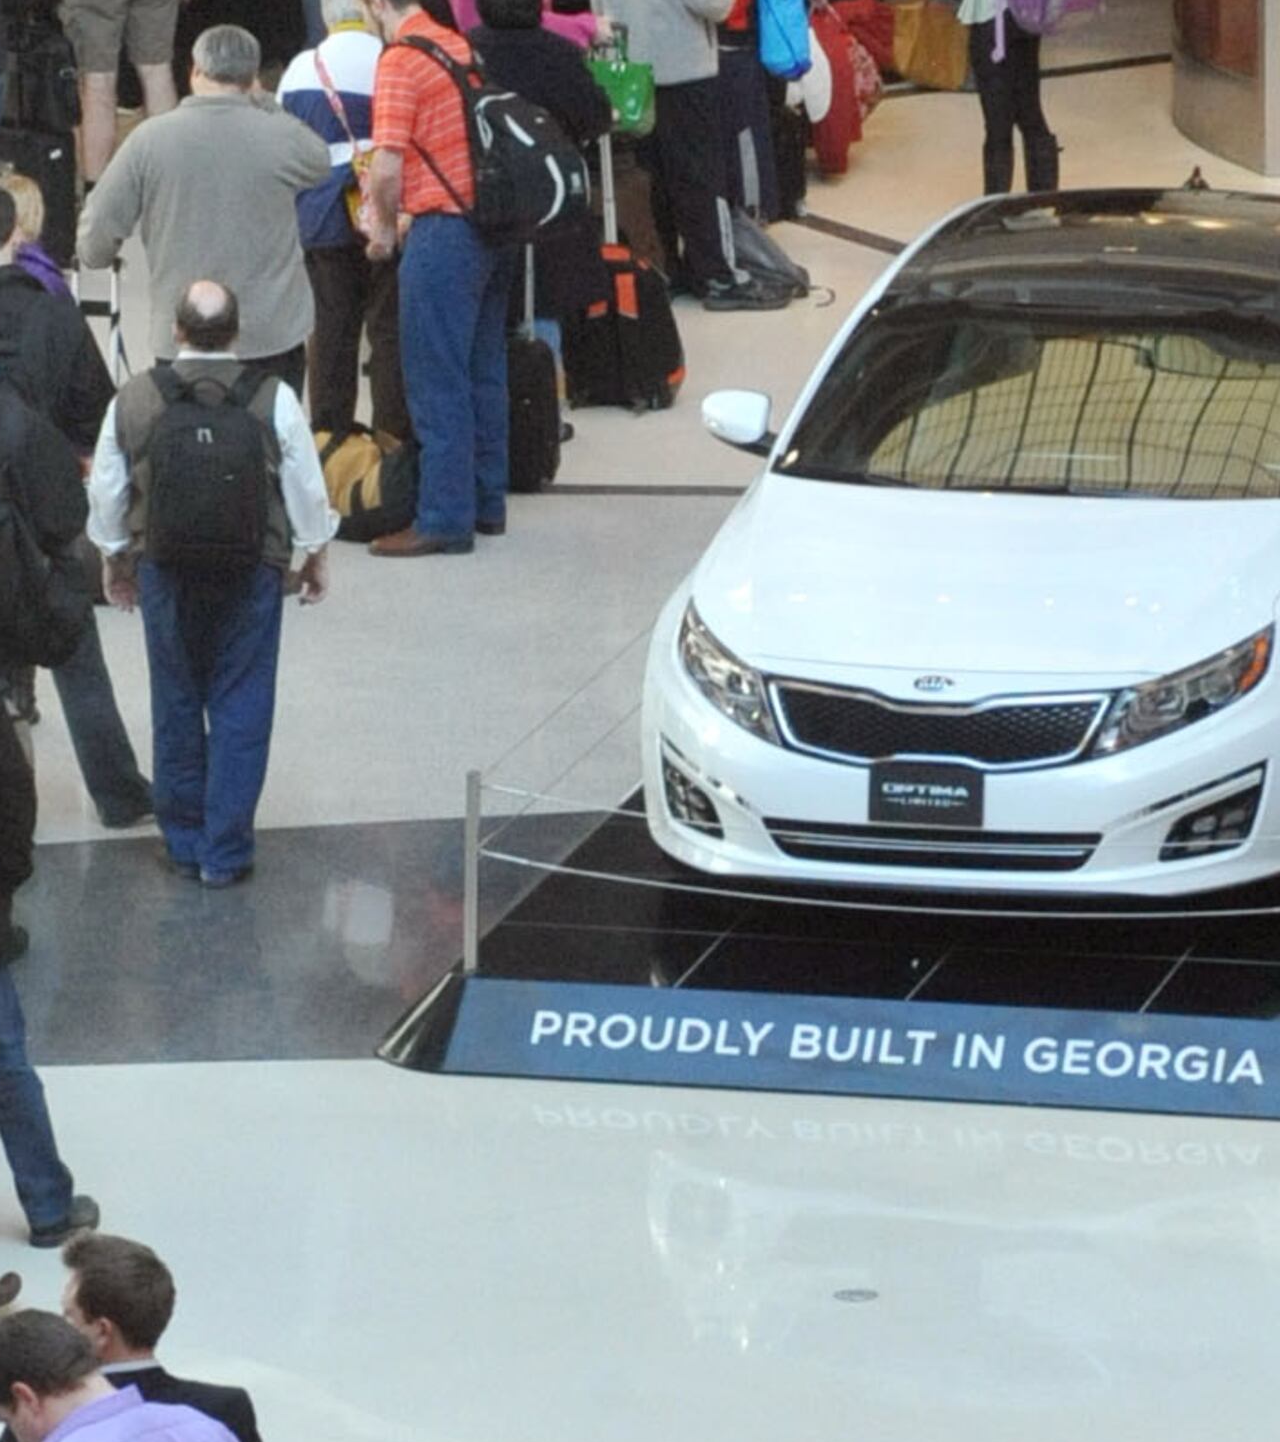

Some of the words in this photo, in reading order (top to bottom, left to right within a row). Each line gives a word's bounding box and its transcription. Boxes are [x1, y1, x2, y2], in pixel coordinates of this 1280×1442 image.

[881, 781, 969, 798] OPTIMA
[530, 1010, 775, 1058] PROUDLY
[788, 1023, 937, 1069] BUILT
[951, 1031, 1006, 1072] IN
[1022, 1036, 1266, 1087] GEORGIA
